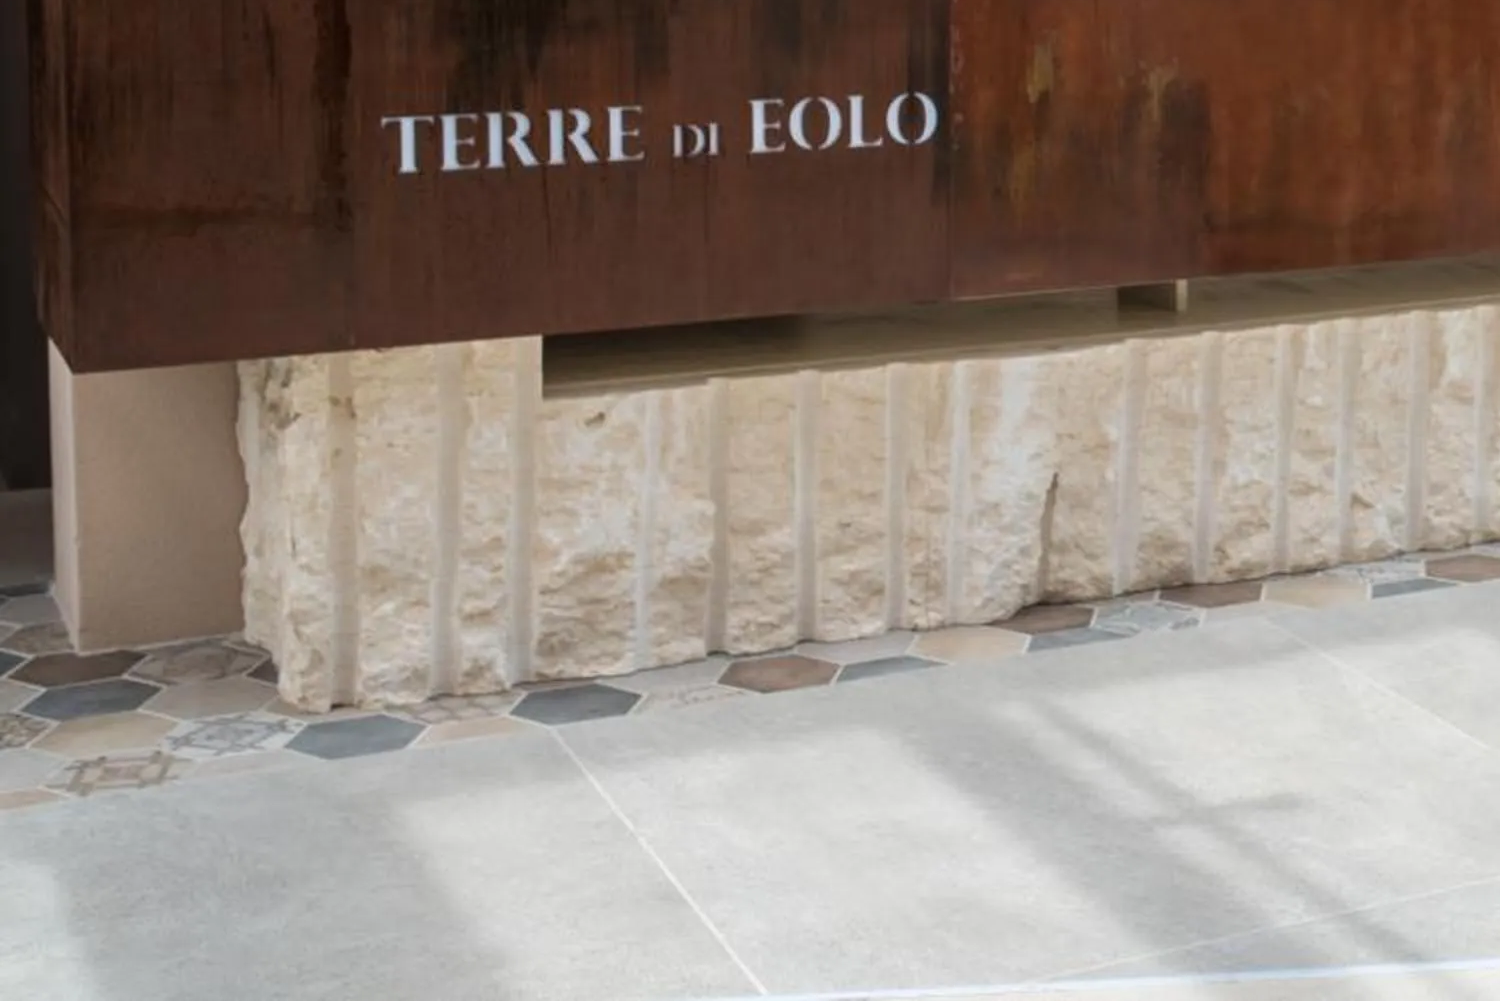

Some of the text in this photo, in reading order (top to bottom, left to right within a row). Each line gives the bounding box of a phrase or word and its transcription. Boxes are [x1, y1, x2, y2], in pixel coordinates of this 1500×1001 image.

[381, 91, 938, 174] TERRE DI EOLO
